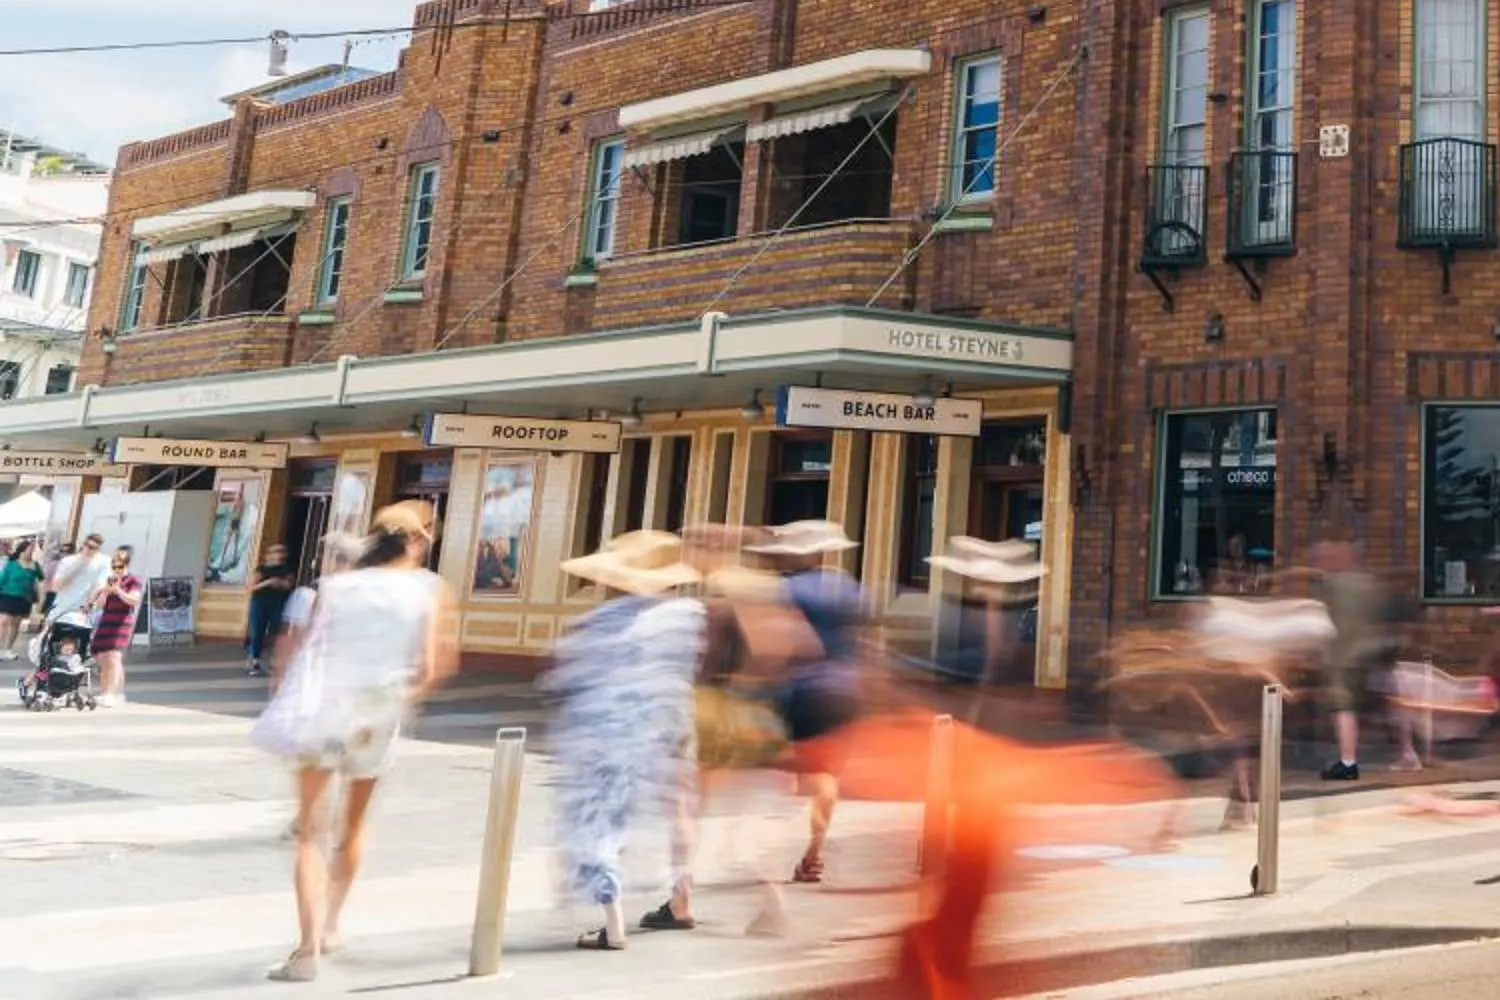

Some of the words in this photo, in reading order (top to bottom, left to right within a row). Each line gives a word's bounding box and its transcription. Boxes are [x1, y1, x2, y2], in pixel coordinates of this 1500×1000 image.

[889, 330, 942, 350] HOTEL
[947, 335, 1010, 358] STEYNE
[843, 401, 897, 418] BEACH
[903, 405, 935, 420] BAR
[492, 425, 569, 441] ROOFTOP
[162, 445, 213, 458] ROUND
[219, 449, 247, 459] BAR
[3, 456, 54, 467] BOTTLE
[59, 459, 95, 468] SHOP
